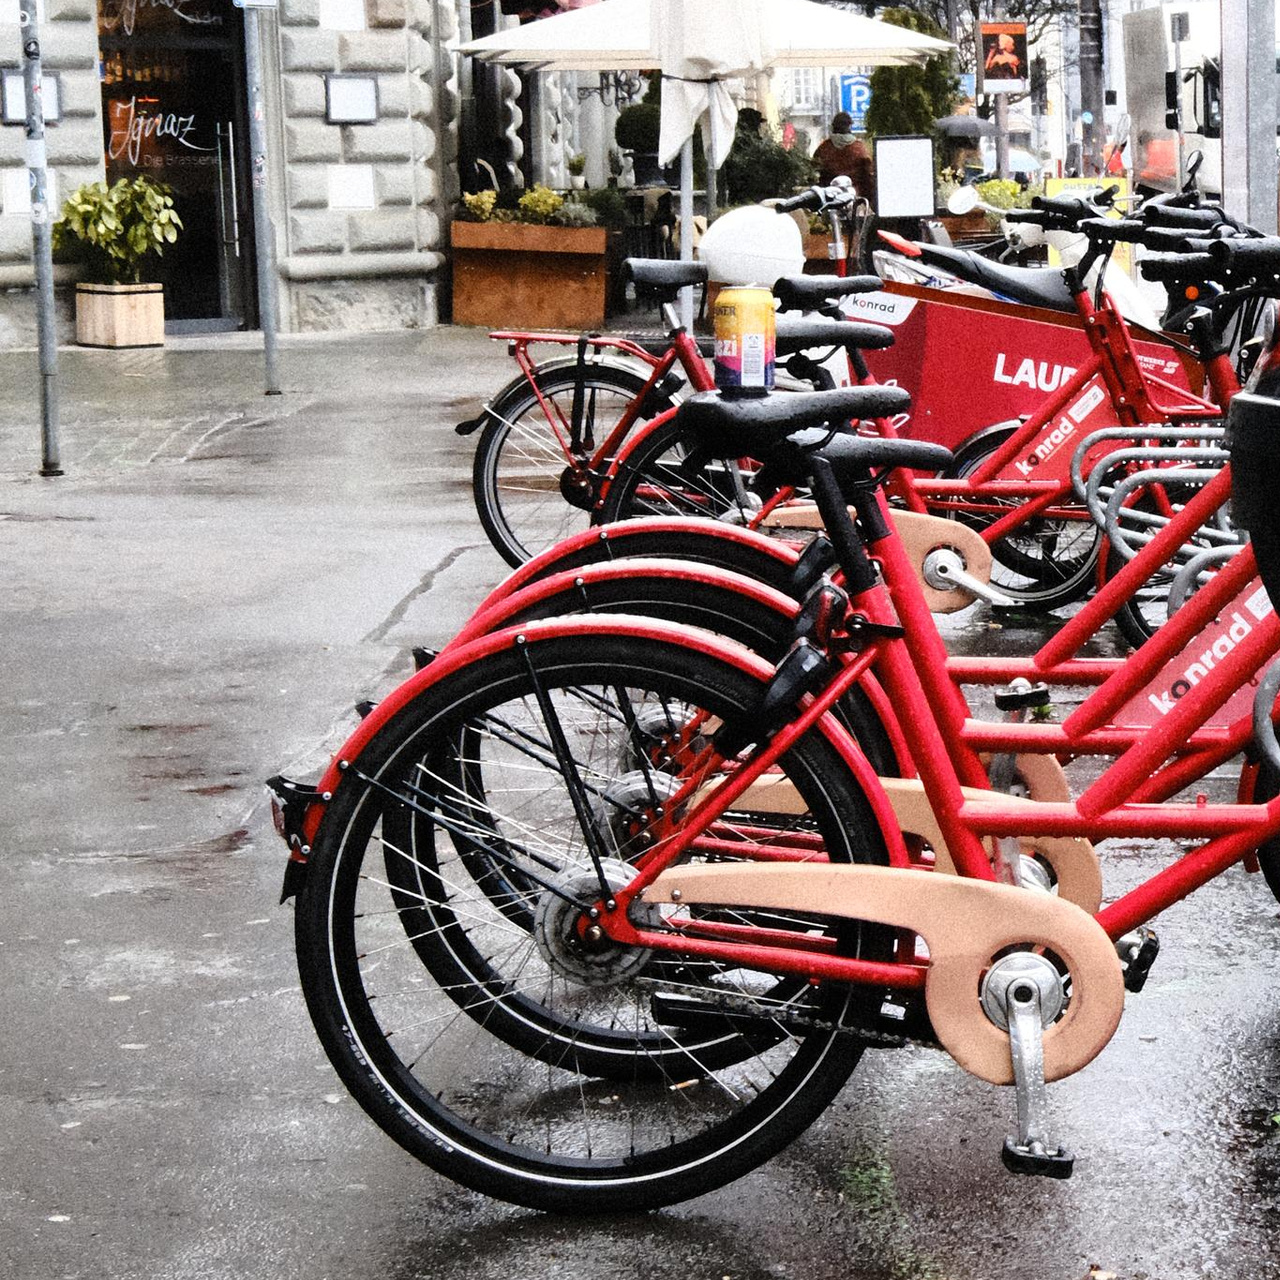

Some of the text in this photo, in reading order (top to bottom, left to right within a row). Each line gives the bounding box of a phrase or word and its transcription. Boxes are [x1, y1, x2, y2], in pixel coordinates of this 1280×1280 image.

[852, 295, 896, 314] konrad
[1014, 416, 1075, 476] konrad
[1148, 612, 1253, 716] konrad
